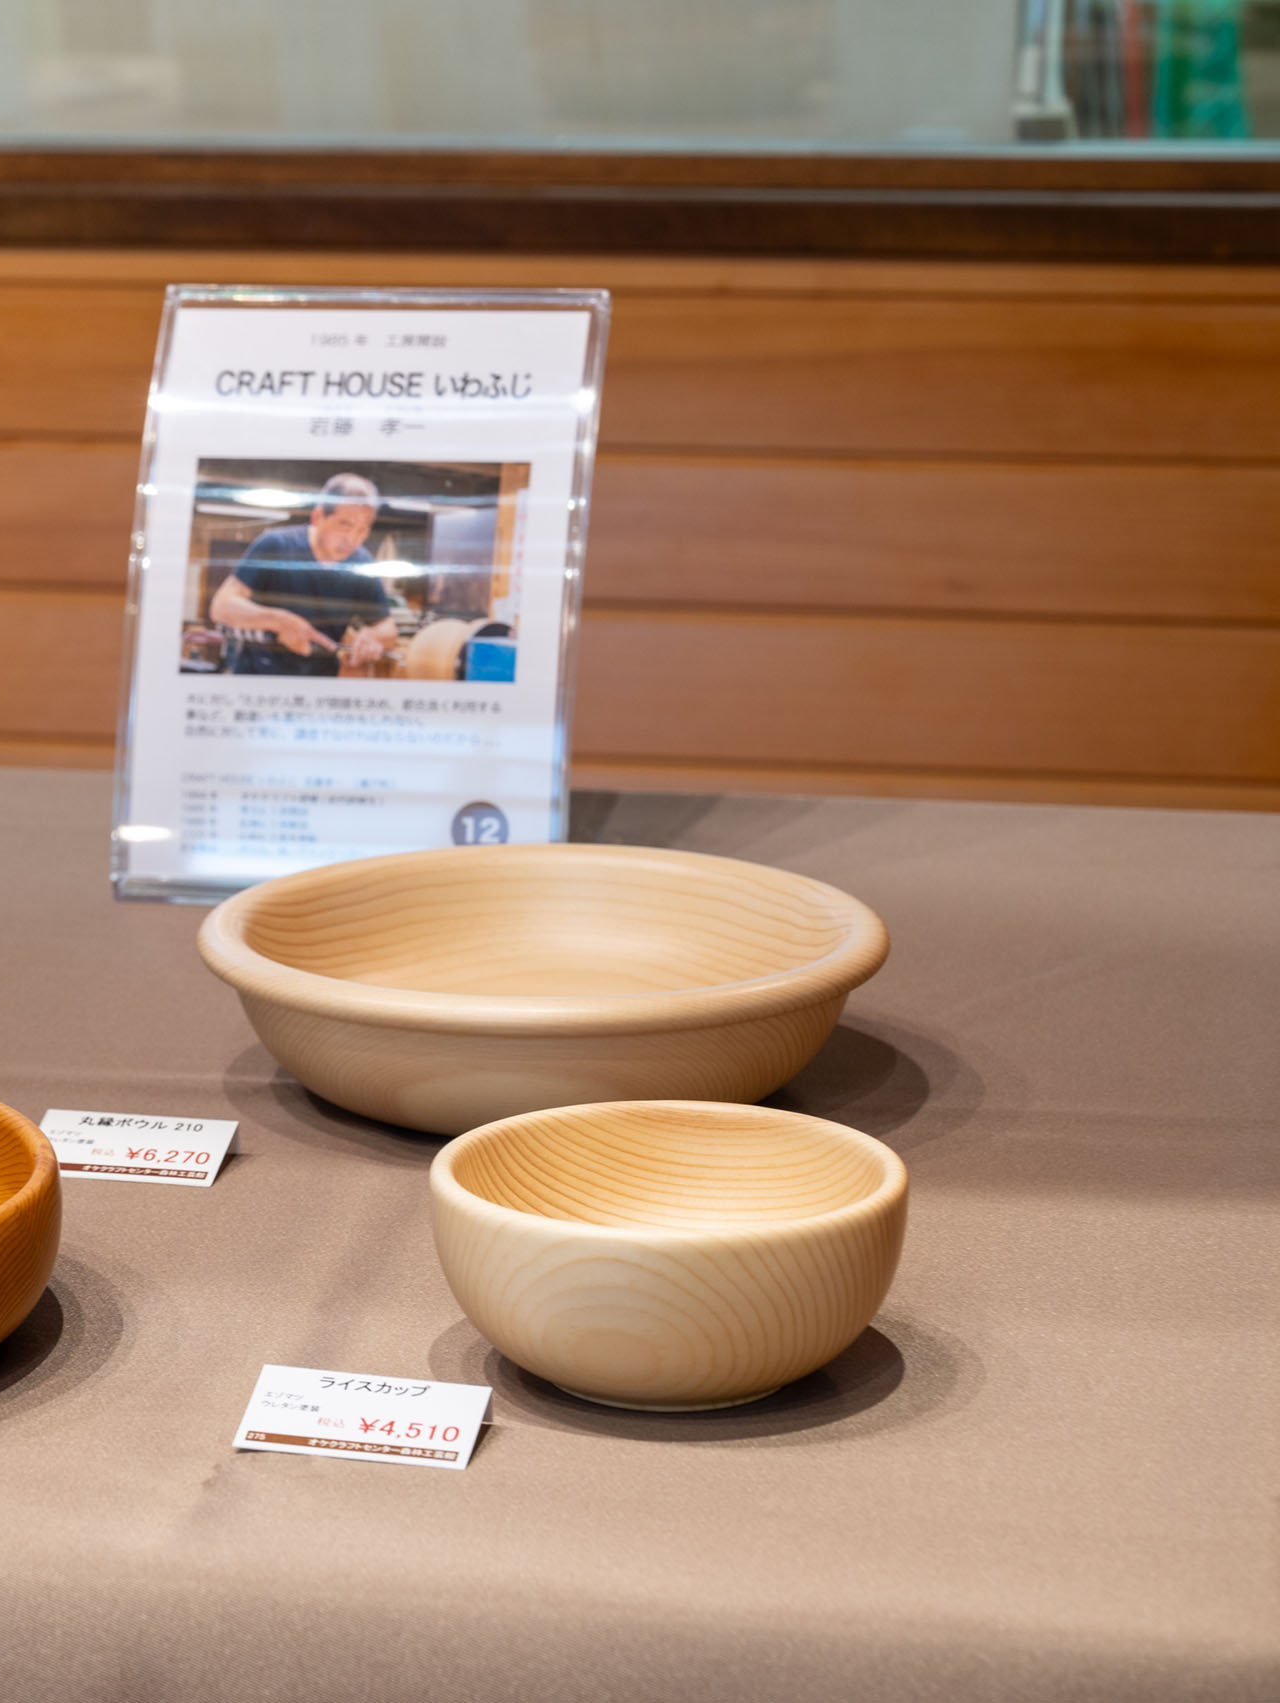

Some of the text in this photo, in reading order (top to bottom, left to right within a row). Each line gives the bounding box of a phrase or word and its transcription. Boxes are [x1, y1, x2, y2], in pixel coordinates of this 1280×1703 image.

[215, 370, 533, 400] CRAFT HOUSE いわふじ
[460, 816, 500, 844] 12
[173, 1122, 203, 1132] 210
[125, 1146, 211, 1165] ¥6,270
[319, 1376, 432, 1397] ライスカップ
[359, 1417, 460, 1442] ¥4,510
